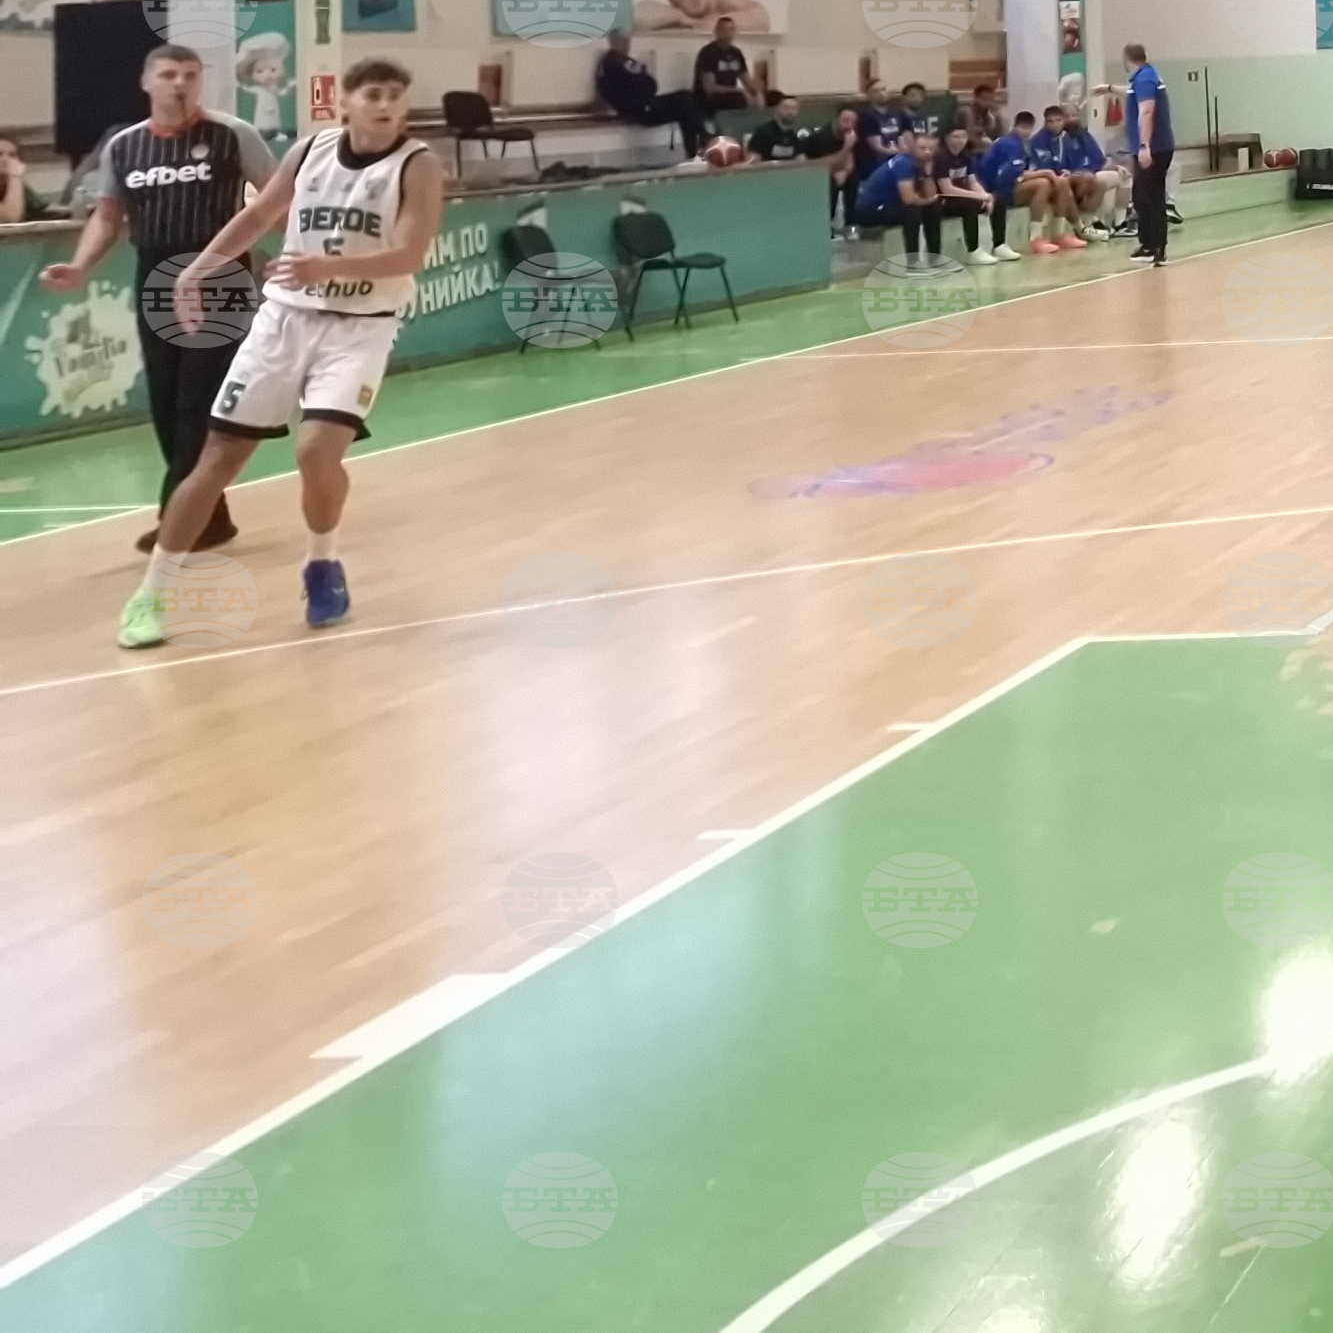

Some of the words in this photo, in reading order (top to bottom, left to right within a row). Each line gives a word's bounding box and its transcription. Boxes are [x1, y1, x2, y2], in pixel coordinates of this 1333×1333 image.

[124, 161, 213, 189] efbet
[460, 222, 488, 259] ПО
[216, 379, 247, 416] 5
